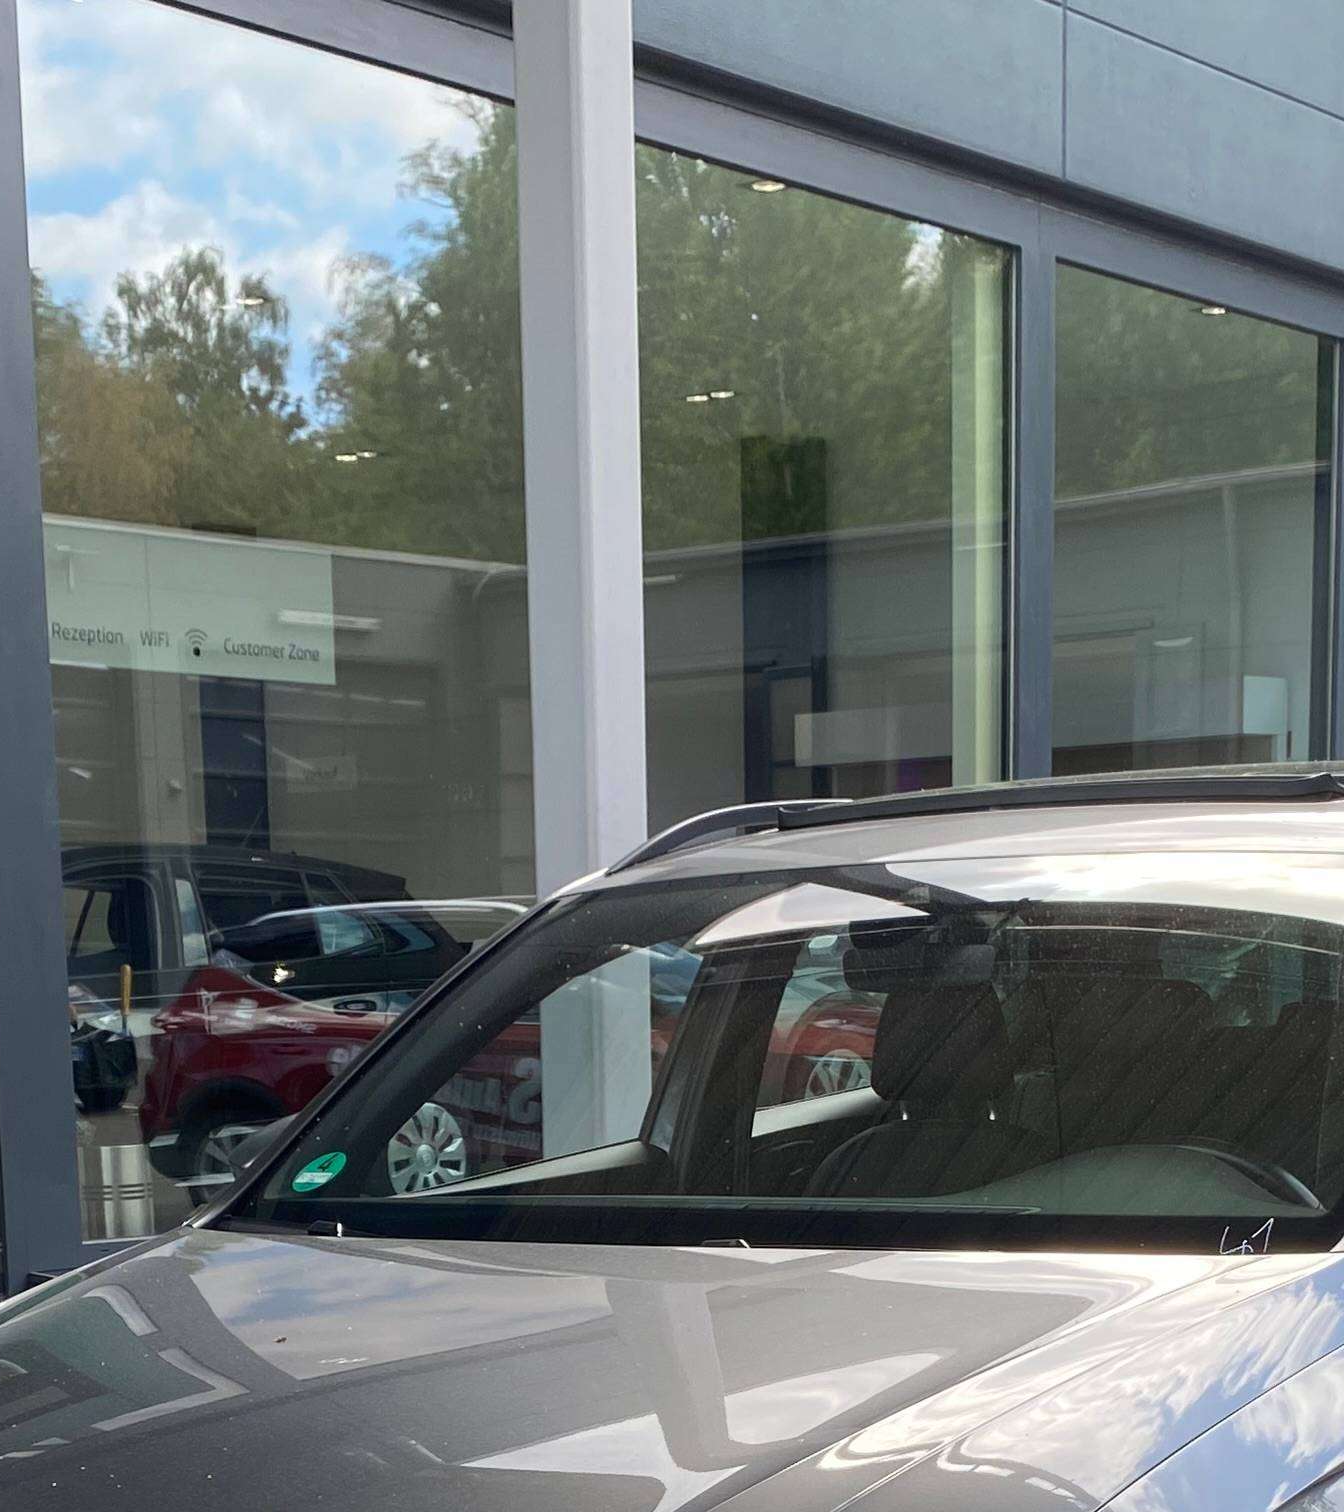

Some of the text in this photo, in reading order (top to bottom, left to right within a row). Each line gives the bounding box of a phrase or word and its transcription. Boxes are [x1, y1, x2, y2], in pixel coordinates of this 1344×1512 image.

[52, 622, 123, 646] Rezeption
[224, 637, 319, 661] Customer Zone
